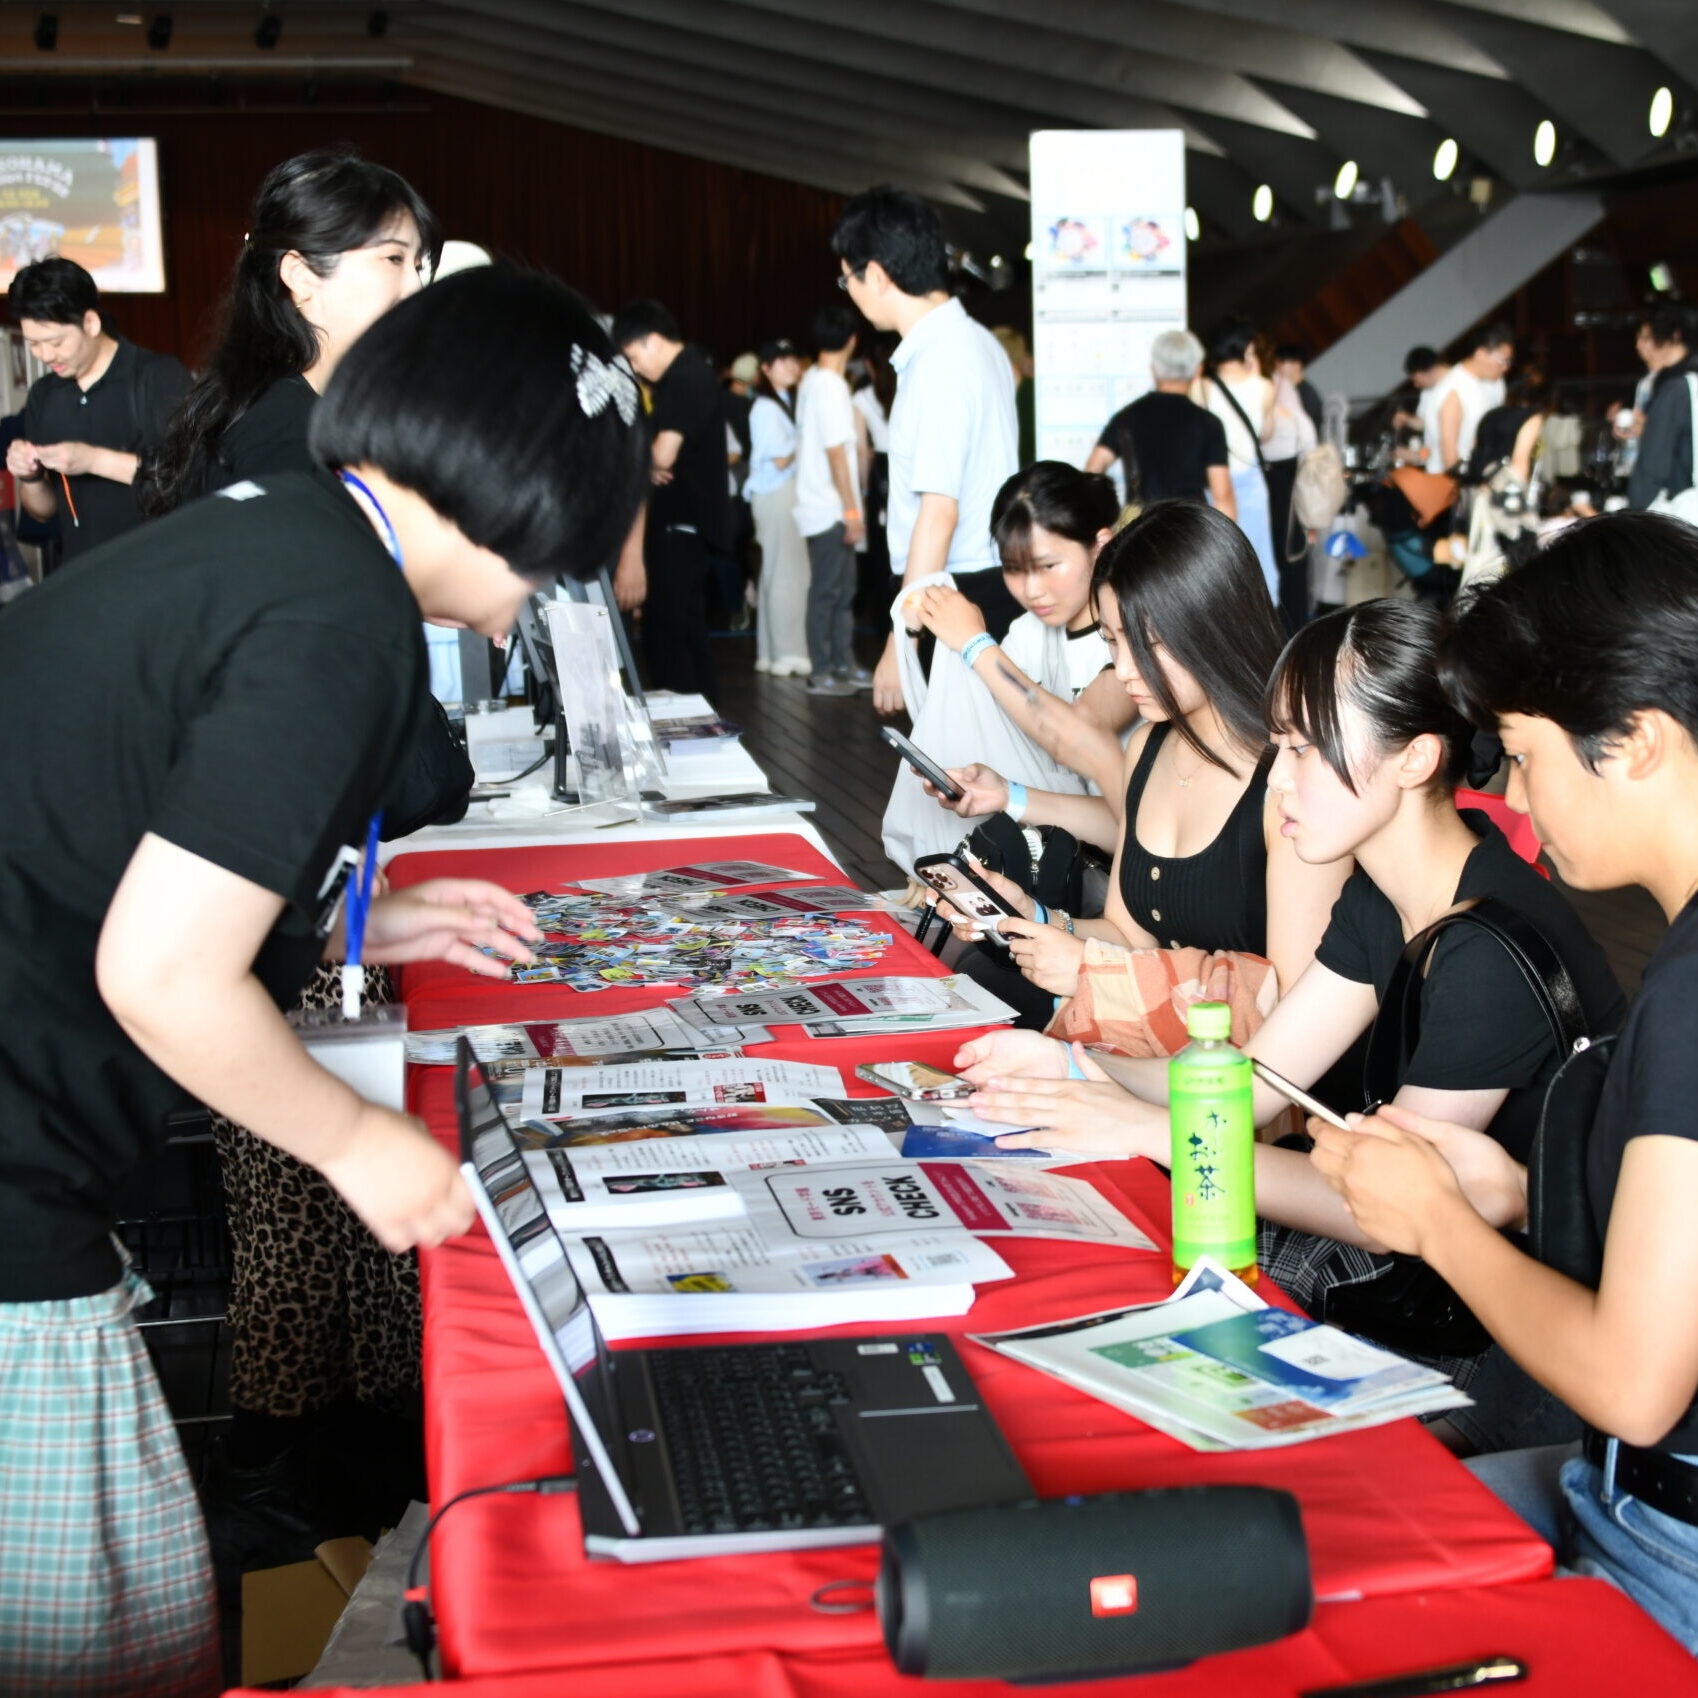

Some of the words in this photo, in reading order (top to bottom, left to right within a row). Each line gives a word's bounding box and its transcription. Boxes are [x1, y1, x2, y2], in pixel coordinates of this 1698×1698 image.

[736, 1003, 767, 1016] SNS
[779, 995, 821, 1015] CHECK
[822, 1187, 866, 1216] SNS
[881, 1175, 940, 1219] CHECK
